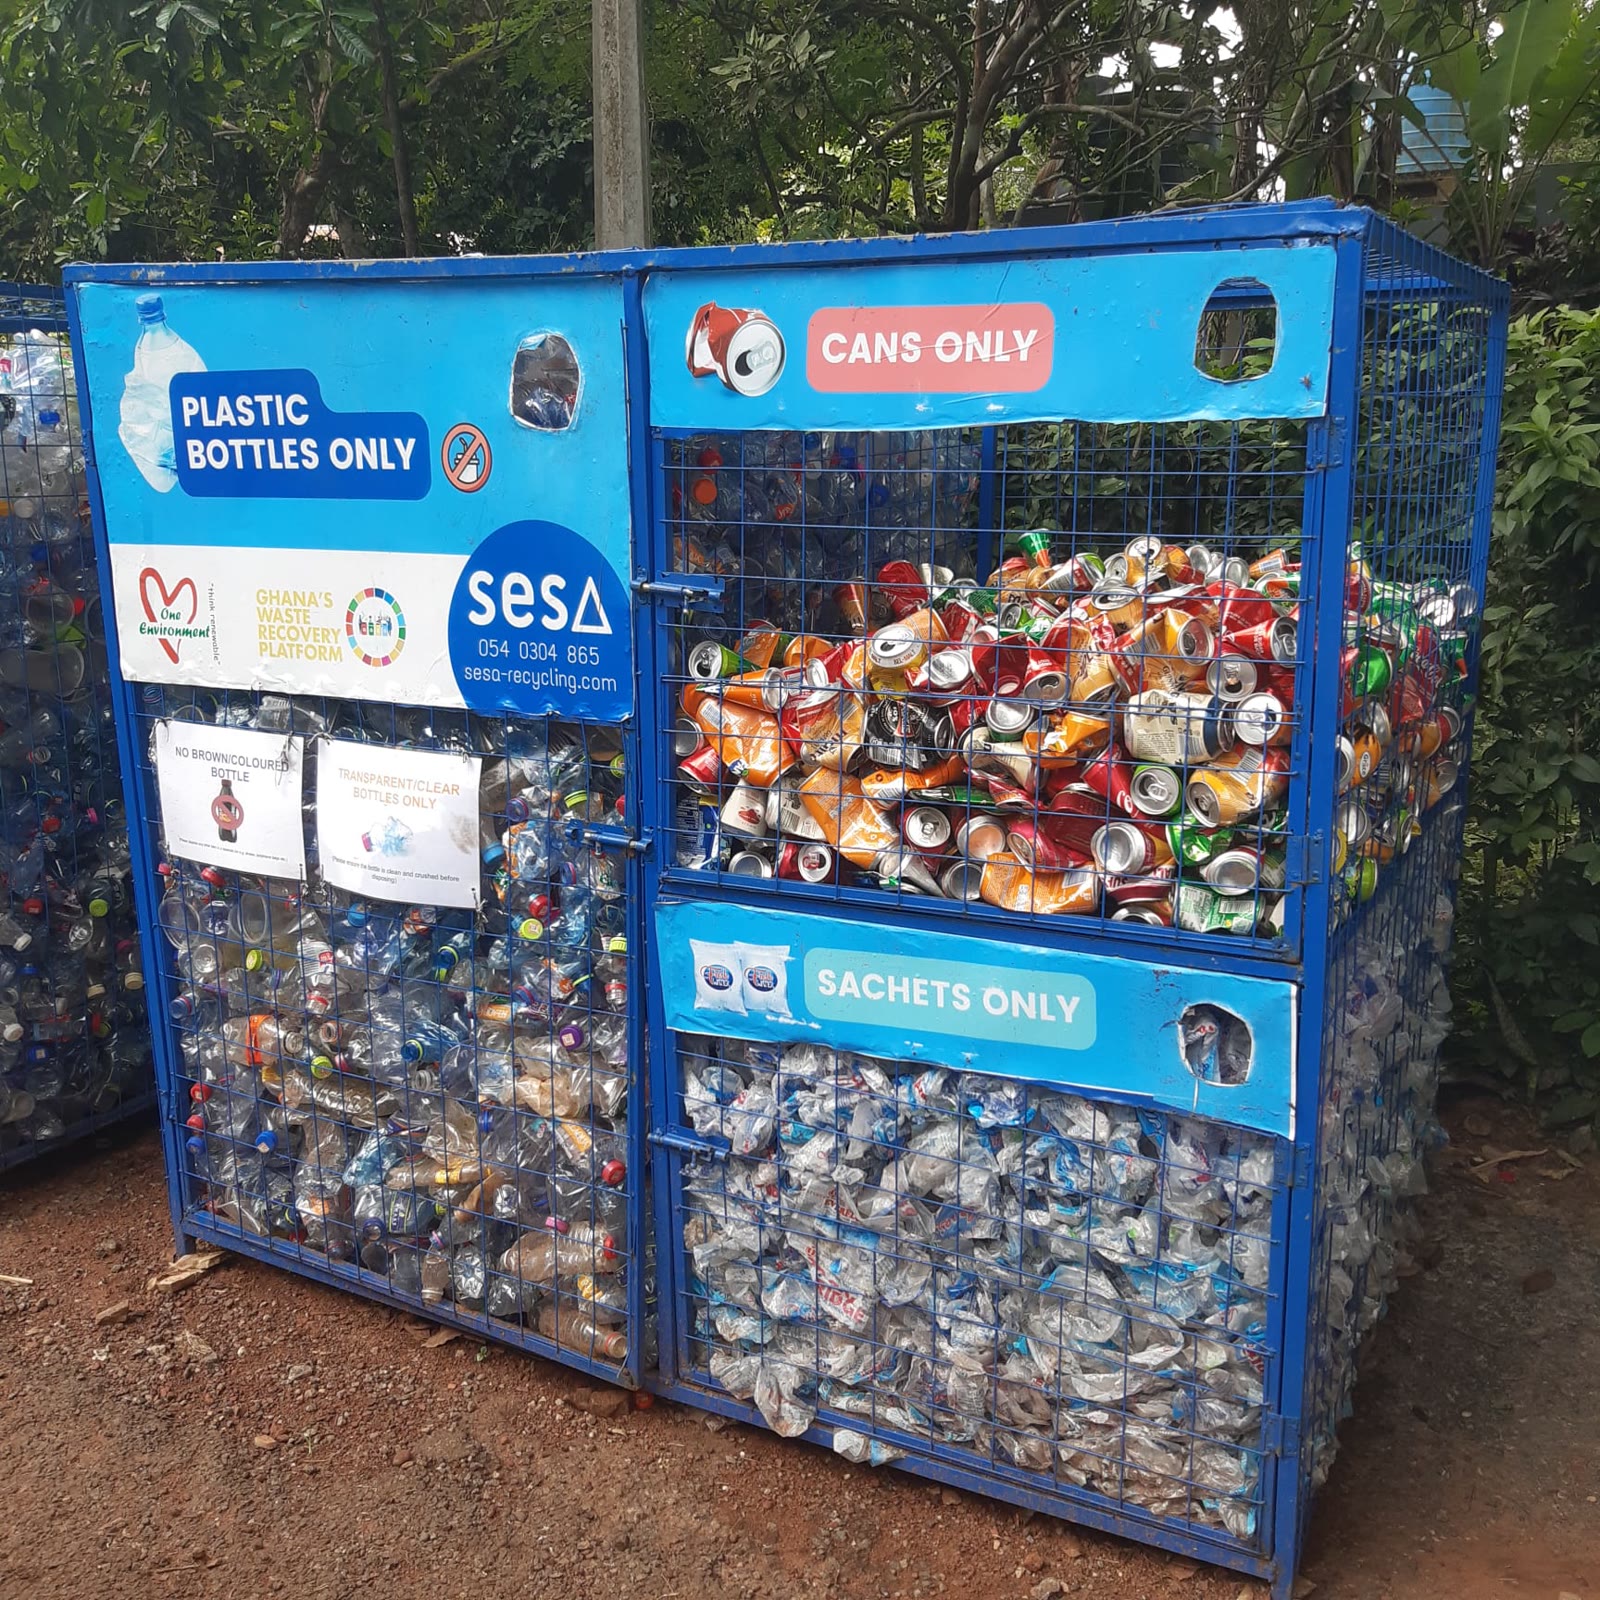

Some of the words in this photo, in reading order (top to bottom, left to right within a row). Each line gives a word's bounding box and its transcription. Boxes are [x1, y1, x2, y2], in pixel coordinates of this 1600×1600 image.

[822, 331, 922, 364] CANS
[935, 329, 1037, 363] ONLY
[182, 394, 309, 427] PLASTIC
[186, 438, 320, 470] BOTTLES
[329, 437, 416, 470] ONLY
[161, 608, 181, 620] One
[256, 607, 311, 625] WASTE
[139, 622, 210, 638] Environment
[258, 625, 341, 644] RECOVERY
[259, 642, 343, 662] PLATFORM
[478, 638, 510, 658] 054
[519, 641, 558, 662] 0304
[567, 645, 600, 666] 865
[464, 666, 617, 694] sesa-recycling.com
[175, 747, 189, 758] NO
[192, 748, 289, 772] BROWN/COLOURED
[211, 767, 250, 782] BOTTLE
[338, 768, 460, 796] TRANSPARENT/CLEAR
[353, 786, 400, 805] BOTTLES
[402, 794, 437, 809] ONLY
[386, 868, 401, 876] clean
[414, 871, 439, 880] crushed
[440, 874, 460, 882] before
[817, 968, 972, 1012] SACHETS
[982, 986, 1081, 1024] ONLY
